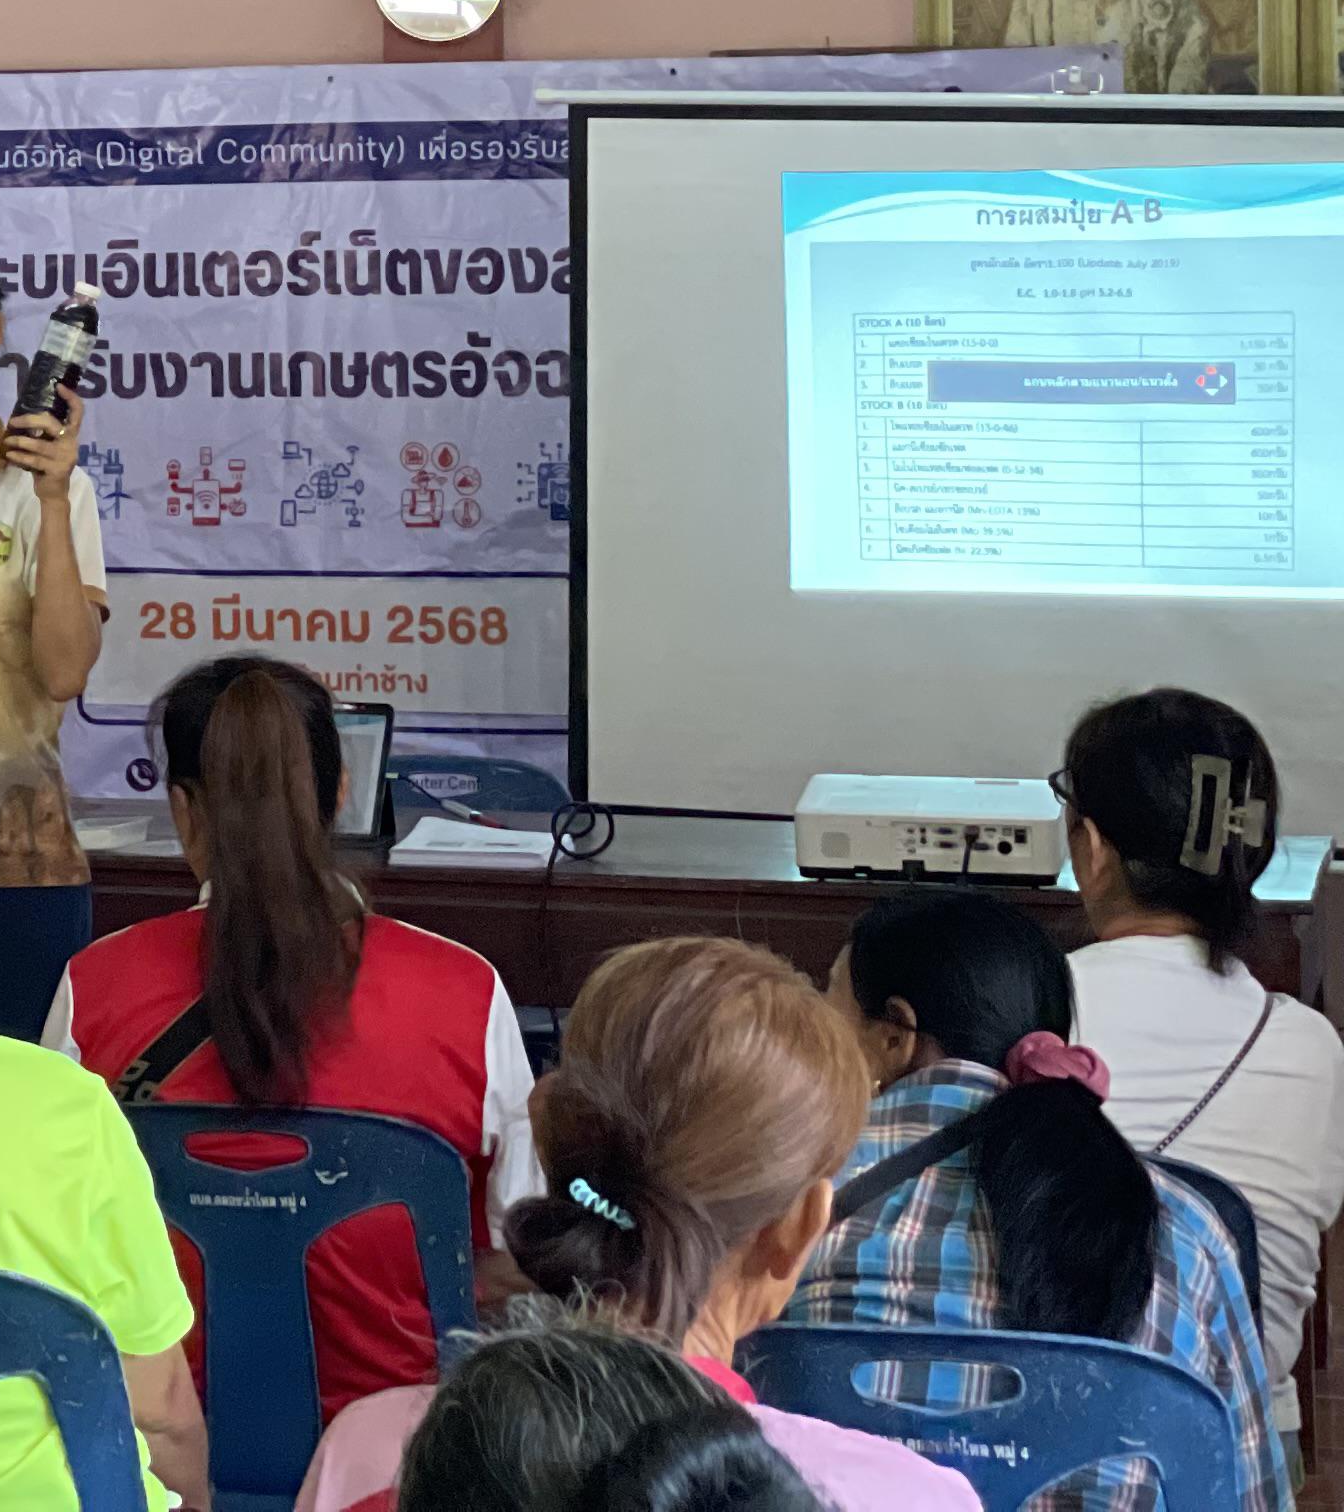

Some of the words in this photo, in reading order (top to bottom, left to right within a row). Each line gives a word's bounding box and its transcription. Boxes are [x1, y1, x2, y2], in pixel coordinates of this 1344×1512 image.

[96, 140, 204, 172] (Digital
[216, 135, 405, 168] Community)
[976, 198, 1102, 231] การผสมปุ๋ย
[1110, 199, 1134, 224] A
[1144, 198, 1163, 223] B
[859, 318, 892, 328] STOCK
[895, 318, 903, 327] A
[860, 400, 893, 410] STOCK
[897, 400, 904, 410] B
[139, 601, 197, 640] 28
[211, 593, 371, 644] มีนาคม
[386, 605, 509, 646] 2568
[1020, 1445, 1029, 1460] 4
